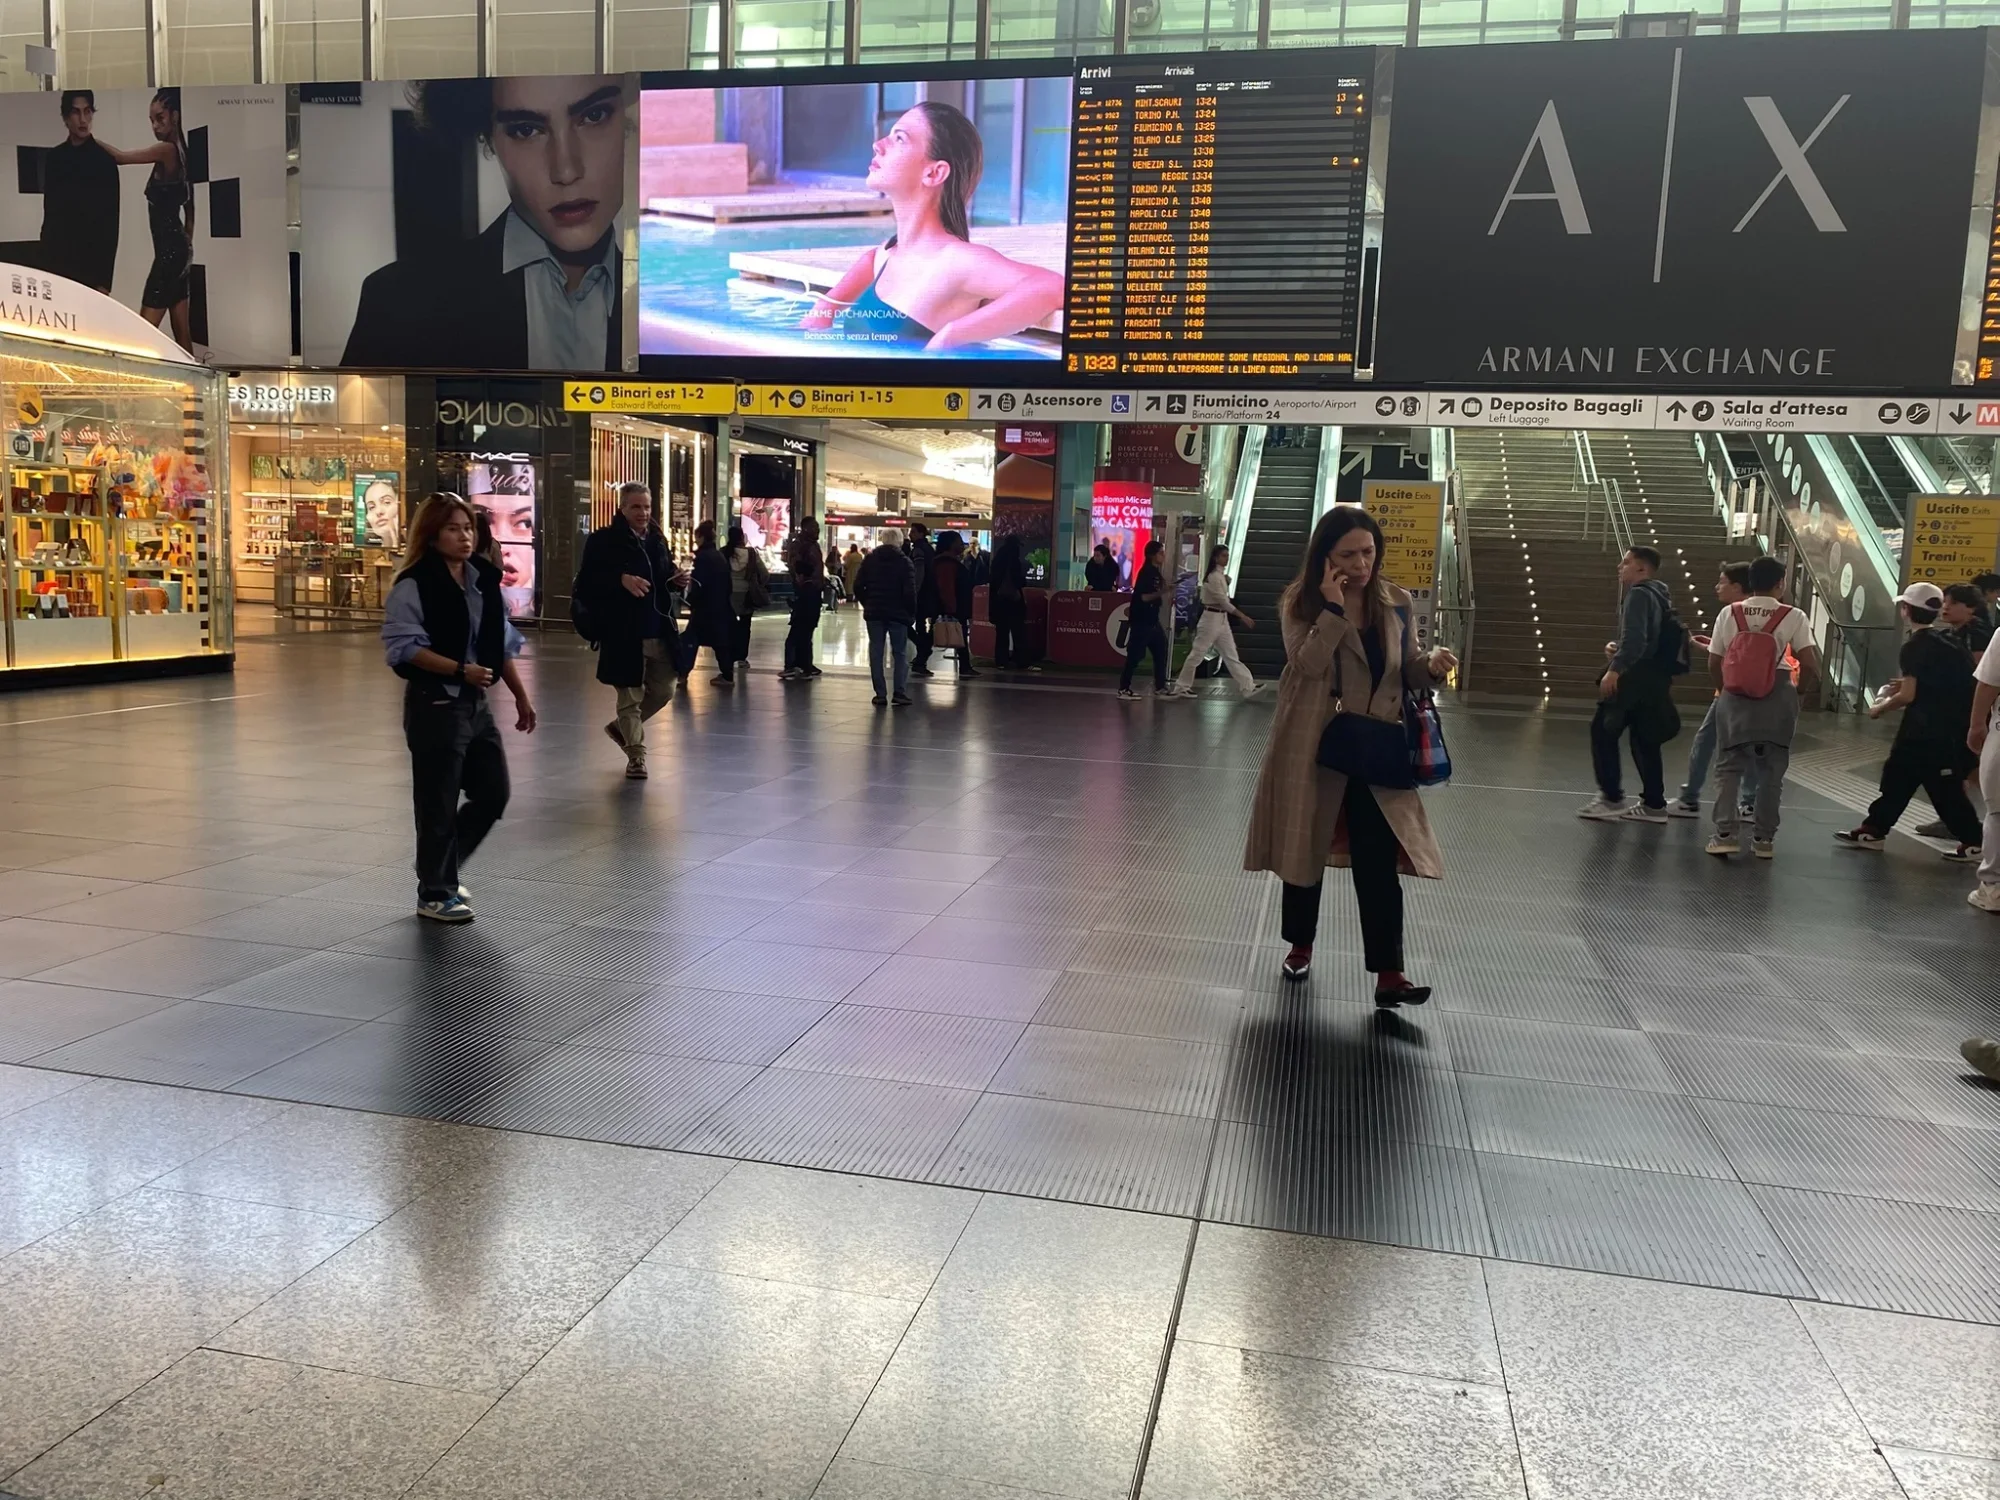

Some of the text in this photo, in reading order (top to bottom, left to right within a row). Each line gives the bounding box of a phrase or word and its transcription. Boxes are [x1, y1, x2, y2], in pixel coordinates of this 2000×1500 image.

[1080, 66, 1112, 78] Arrivi
[1164, 66, 1194, 76] Arrivals
[1196, 97, 1216, 106] 13:24
[1336, 94, 1346, 102] 13
[1195, 110, 1216, 118] 13:24
[1336, 106, 1342, 115] 3
[1135, 111, 1161, 120] TORINO
[1134, 123, 1172, 132] FIUMICINO
[1195, 122, 1215, 130] 13:25
[1134, 136, 1160, 144] MILANO
[1194, 135, 1214, 143] 13:25
[1193, 147, 1214, 156] 13:30
[1133, 160, 1164, 169] VENEZIA
[1193, 159, 1213, 168] 13:30
[1332, 157, 1338, 165] 2
[1192, 172, 1212, 180] 13:34
[1132, 185, 1157, 193] TORINO
[1192, 184, 1212, 192] 13:35
[1131, 197, 1168, 206] FIUMICINO
[1130, 210, 1157, 218] NAPOLI
[1129, 222, 1167, 230] AVEZZANO
[1190, 221, 1210, 229] 13:45
[1128, 246, 1154, 255] MILANO
[1188, 246, 1208, 254] 13:49
[1128, 259, 1165, 267] FIUMICINO
[1188, 258, 1208, 266] 13:55
[1127, 271, 1154, 279] NAPOLI
[1186, 270, 1207, 278] 13:55
[1127, 283, 1162, 291] VELLETRI
[1186, 282, 1206, 291] 13:59
[1126, 295, 1156, 303] TRIESTE
[804, 310, 831, 318] TERME
[848, 309, 907, 319] CHIANCIANO
[1125, 307, 1152, 315] NAPOLI
[0, 300, 77, 332] MAJANI
[1125, 319, 1160, 327] FRASCATI
[804, 332, 844, 340] Benessere
[871, 333, 898, 342] tempo
[1124, 332, 1161, 340] FIUMICINO
[1142, 353, 1169, 361] WORKS.
[1173, 353, 1225, 361] FURTHERMORE
[1229, 353, 1248, 361] SOME
[1253, 353, 1290, 361] REGIONAL
[1295, 353, 1309, 361] AND
[1314, 353, 1334, 361] LONG
[1477, 347, 1836, 376] ARMANI EXCHANGE
[1084, 355, 1116, 370] 13:23
[1134, 365, 1163, 373] VIETATO
[1168, 365, 1224, 373] OLTREPASSARE
[1228, 365, 1238, 373] LA
[1243, 365, 1265, 373] LINEA
[1270, 365, 1298, 373] GIALLA
[256, 386, 332, 401] ROCHER
[611, 387, 704, 399] Binari est 1-2
[812, 390, 893, 403] Binari 1-15
[1023, 393, 1102, 406] Ascensore
[1193, 394, 1357, 410] Fiumicino Aeroporto/Airport
[241, 402, 292, 410] FRANCE
[611, 400, 682, 410] Eastward Platforms
[811, 405, 847, 414] Platforms
[1490, 397, 1643, 416] Deposito Bagagli
[1723, 400, 1848, 416] Sala d'attesa
[1021, 408, 1034, 417] Lift
[1192, 410, 1280, 420] Binario/Platform 24
[1978, 406, 2000, 422] M
[1489, 413, 1550, 426] Left Luggage
[1722, 418, 1794, 430] Waiting Room
[783, 438, 809, 452] MAC
[470, 452, 530, 462] MAC
[604, 480, 626, 491] MA
[1376, 489, 1431, 500] Uscite Exits
[1126, 496, 1139, 504] Mic
[1107, 506, 1118, 517] IN
[1927, 503, 1990, 515] Uscite Exits
[1109, 517, 1138, 528] CASA
[1384, 534, 1428, 544] eni Trains
[1922, 551, 1986, 562] Treni Trains
[1744, 607, 1762, 616] BEST
